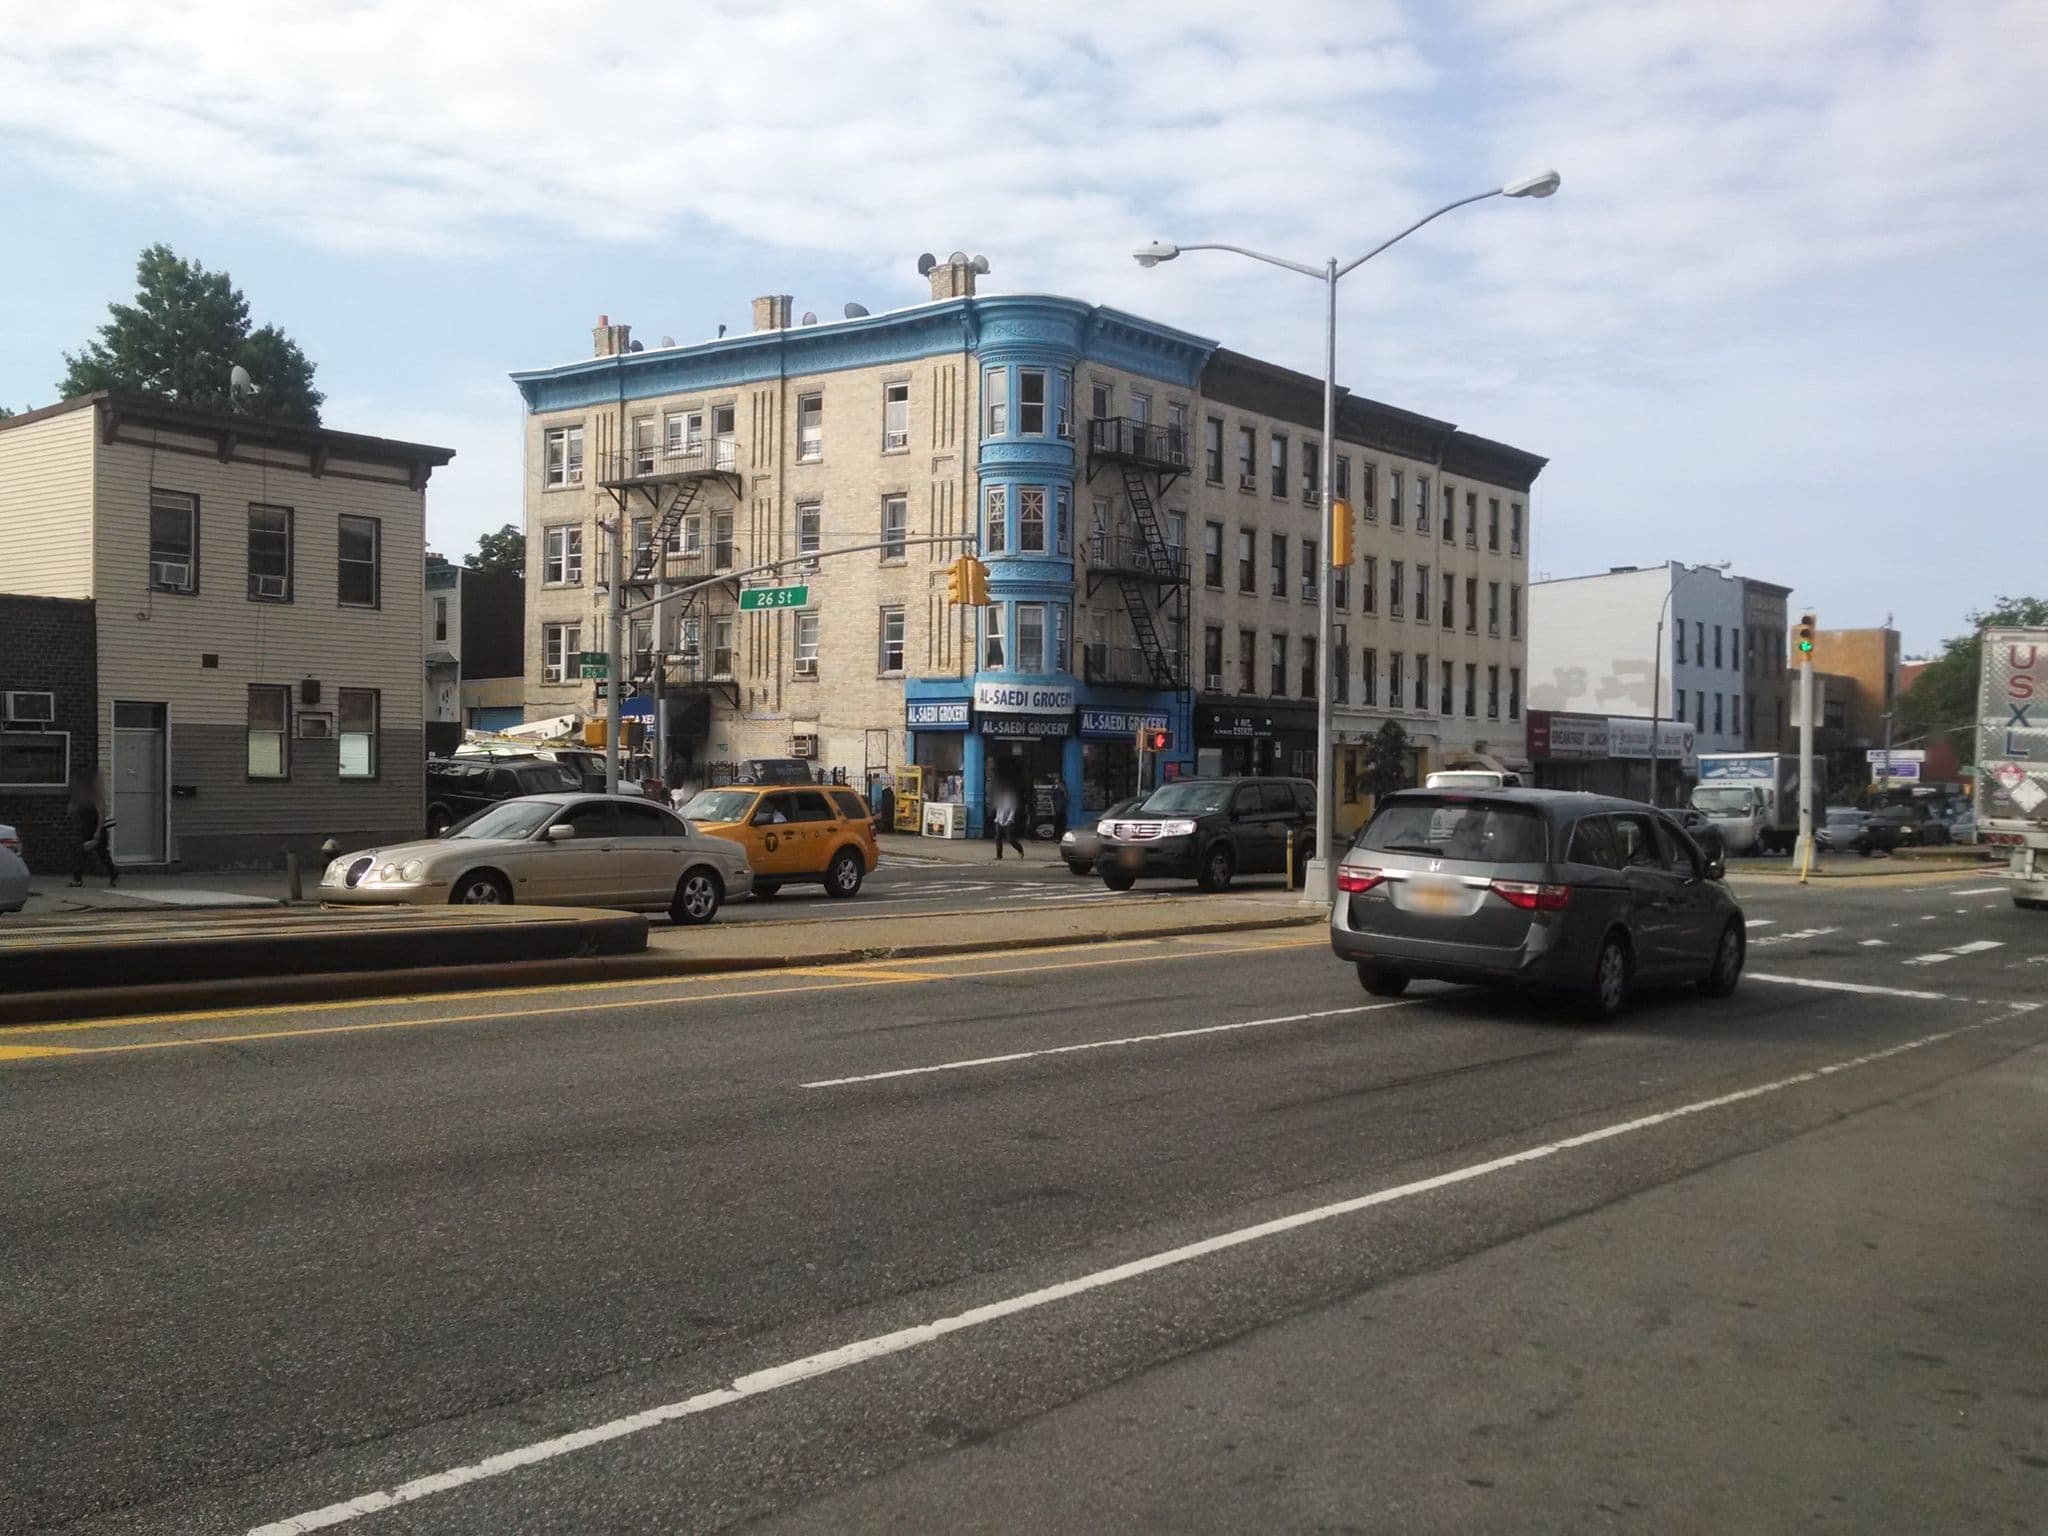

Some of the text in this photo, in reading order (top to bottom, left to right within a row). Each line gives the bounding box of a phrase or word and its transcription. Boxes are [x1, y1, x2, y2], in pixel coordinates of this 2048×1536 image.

[757, 591, 792, 606] 26 St
[586, 668, 598, 678] 26
[979, 689, 1072, 708] AL-SAEDI GROCERY
[908, 706, 968, 722] AL-SAEDI GROCERY
[1082, 713, 1126, 730] AL-SAEDI
[982, 720, 1069, 735] AL-SAEDI GROCERY
